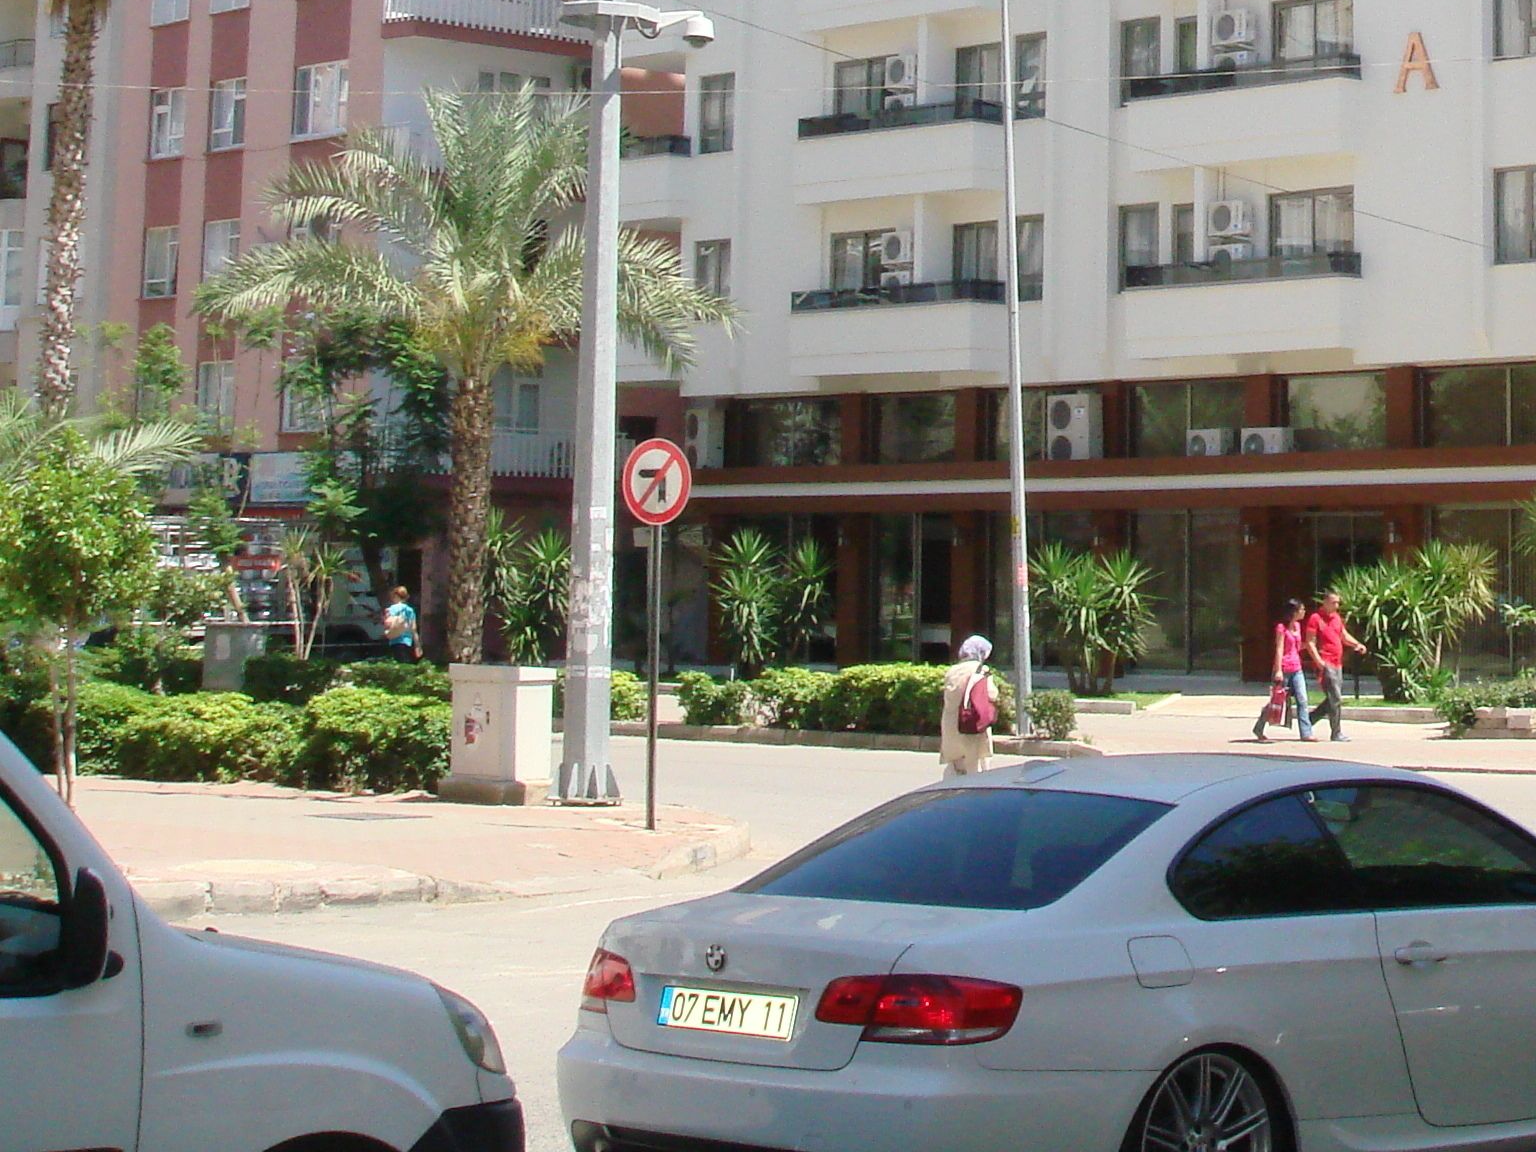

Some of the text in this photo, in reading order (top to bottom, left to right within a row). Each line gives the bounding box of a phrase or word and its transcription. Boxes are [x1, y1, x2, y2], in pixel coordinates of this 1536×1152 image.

[672, 992, 786, 1033] 07 EMY 11
